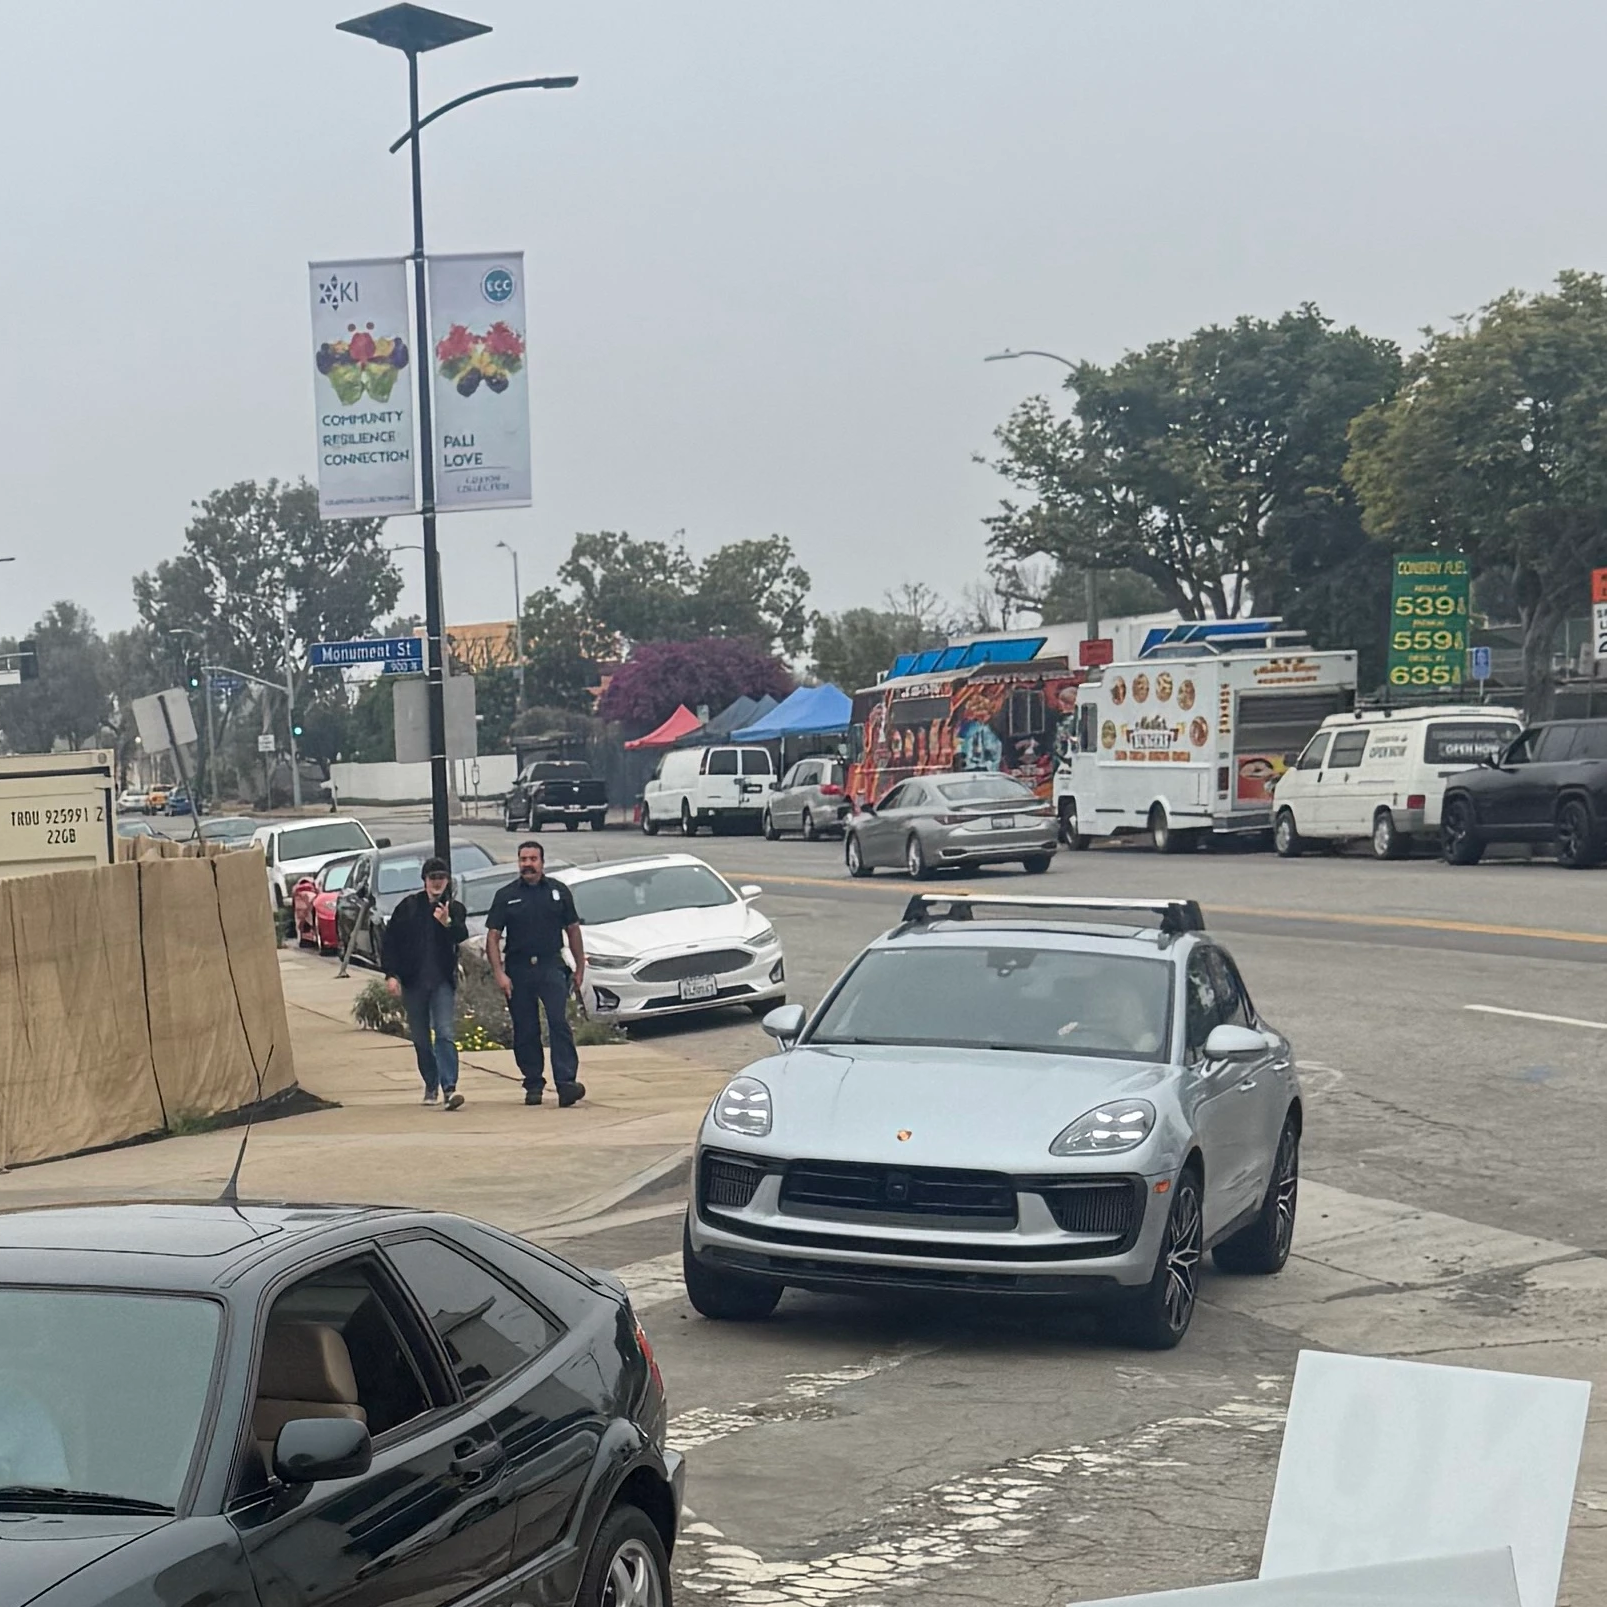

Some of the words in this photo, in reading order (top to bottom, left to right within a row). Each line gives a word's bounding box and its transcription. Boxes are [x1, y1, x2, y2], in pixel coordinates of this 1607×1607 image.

[340, 281, 359, 302] KI
[322, 410, 403, 426] COMMUNITY
[323, 430, 396, 446] RESILIENCE
[443, 433, 475, 448] PALI
[324, 449, 410, 466] CONNECTION
[444, 452, 483, 467] LOVE
[1395, 595, 1455, 616] 539
[1392, 630, 1453, 650] 559
[321, 643, 391, 662] Monument
[397, 641, 412, 657] St
[1389, 665, 1450, 685] 635
[45, 807, 89, 824] 925991
[96, 806, 105, 822] 2
